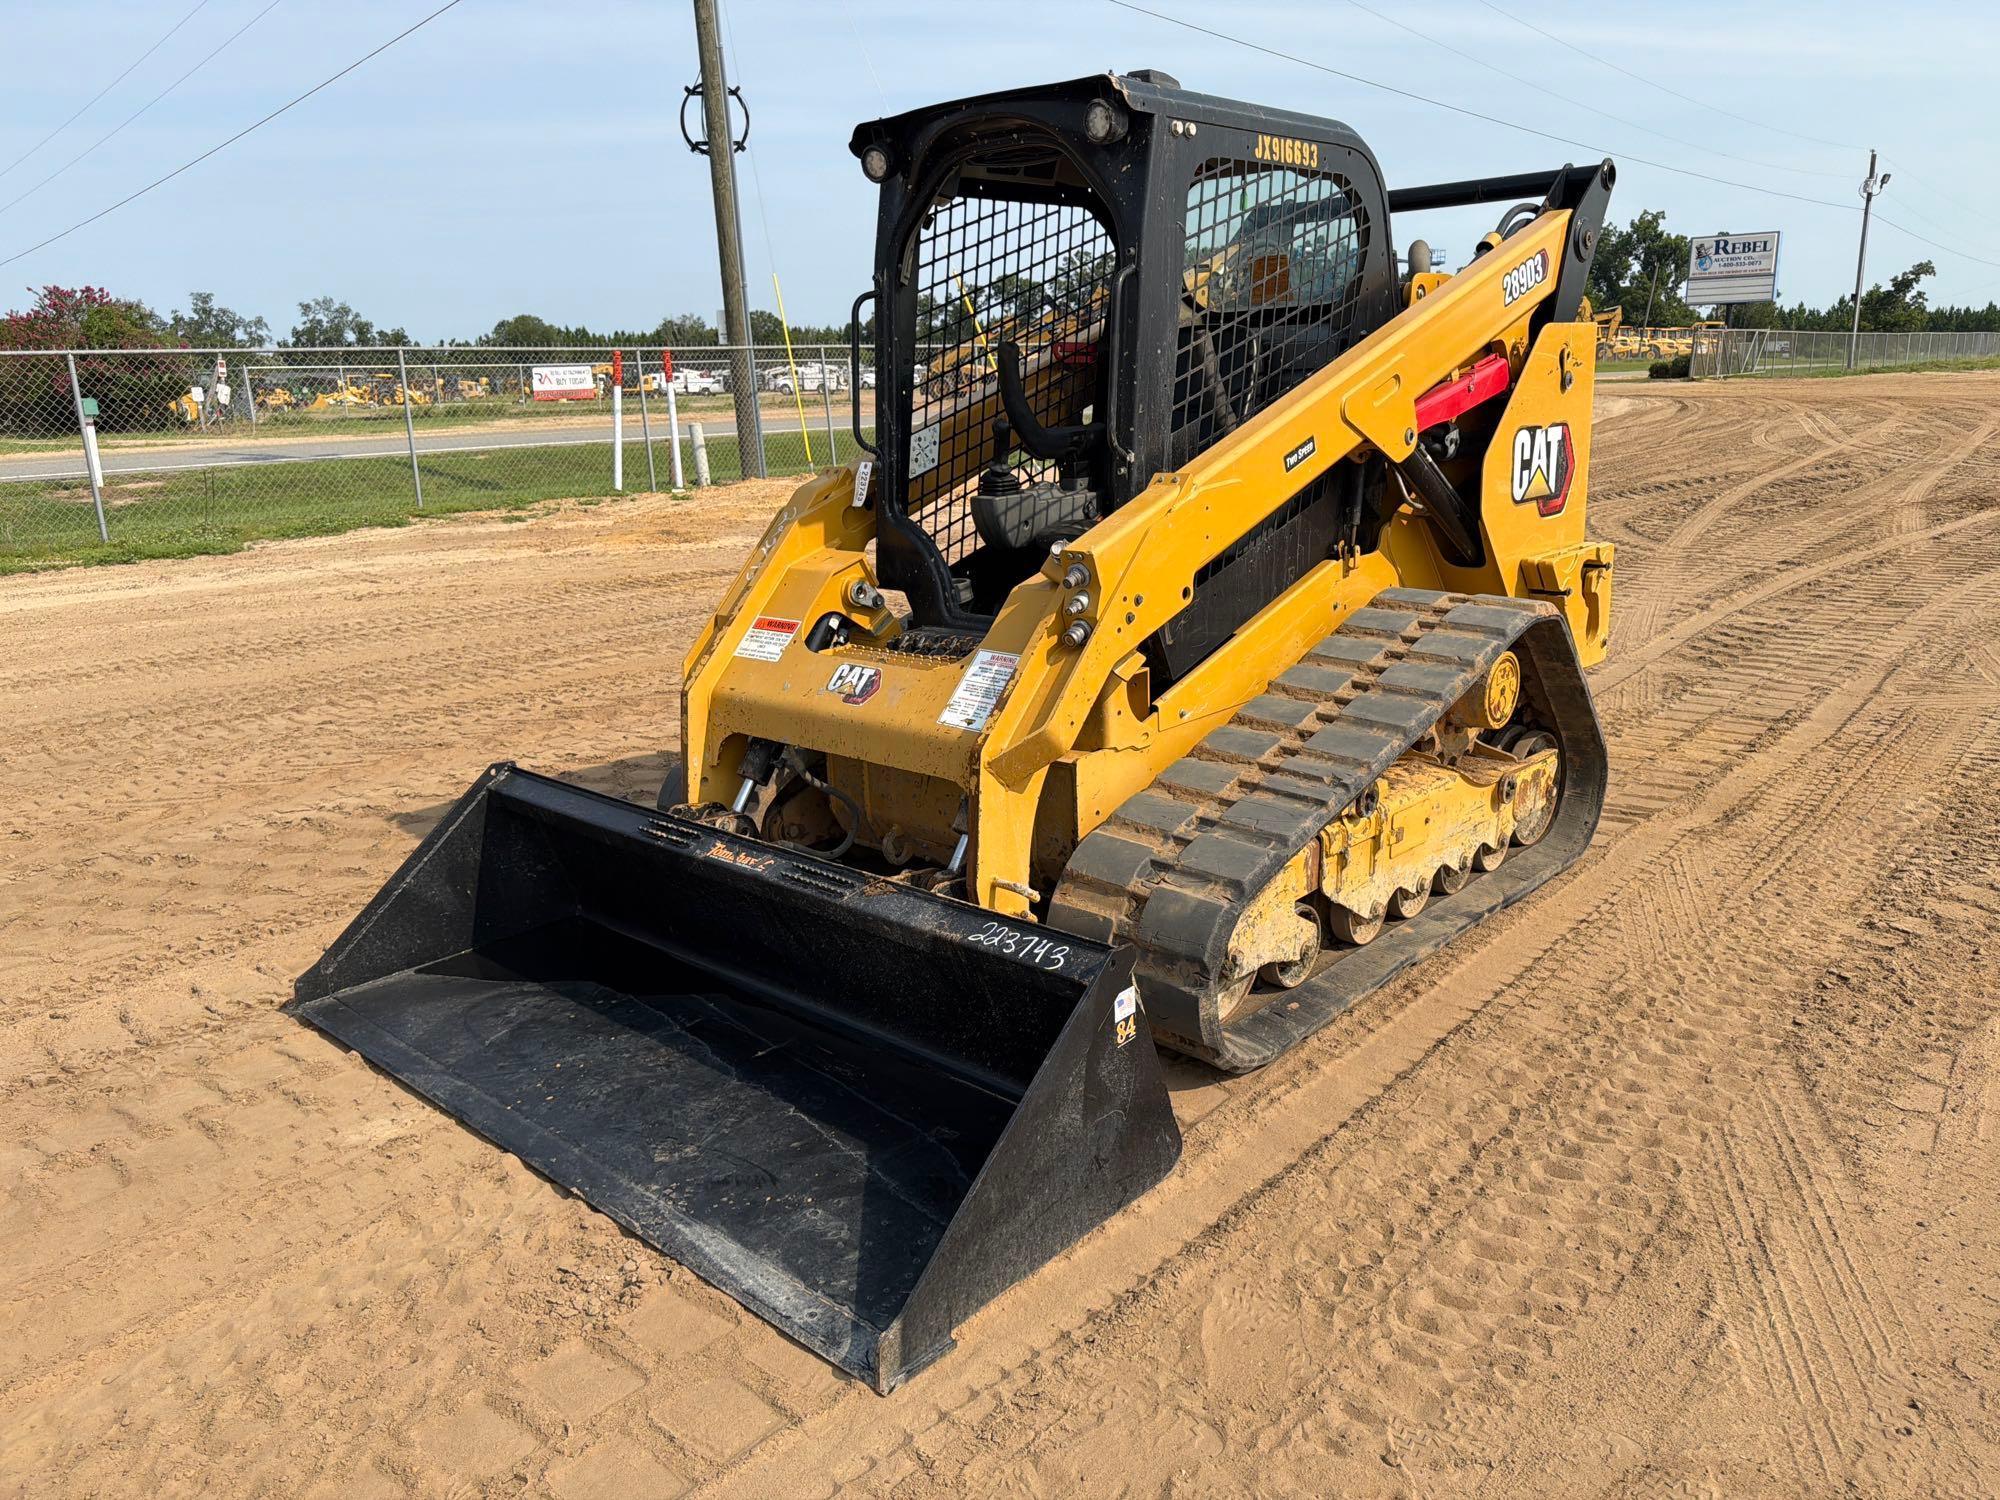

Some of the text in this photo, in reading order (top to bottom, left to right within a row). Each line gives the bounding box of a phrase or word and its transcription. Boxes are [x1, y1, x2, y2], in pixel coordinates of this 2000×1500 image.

[1254, 134, 1318, 168] JX916693
[1713, 239, 1772, 255] REBEL
[1713, 255, 1742, 263] AUCTION
[1503, 253, 1543, 304] 289D3
[1512, 425, 1563, 501] CAT
[857, 471, 869, 502] 223743
[766, 620, 797, 631] WARNING
[990, 654, 1018, 664] WARNING
[827, 663, 876, 696] CAT
[968, 922, 1070, 970] 223743
[1116, 1014, 1137, 1045] 84
